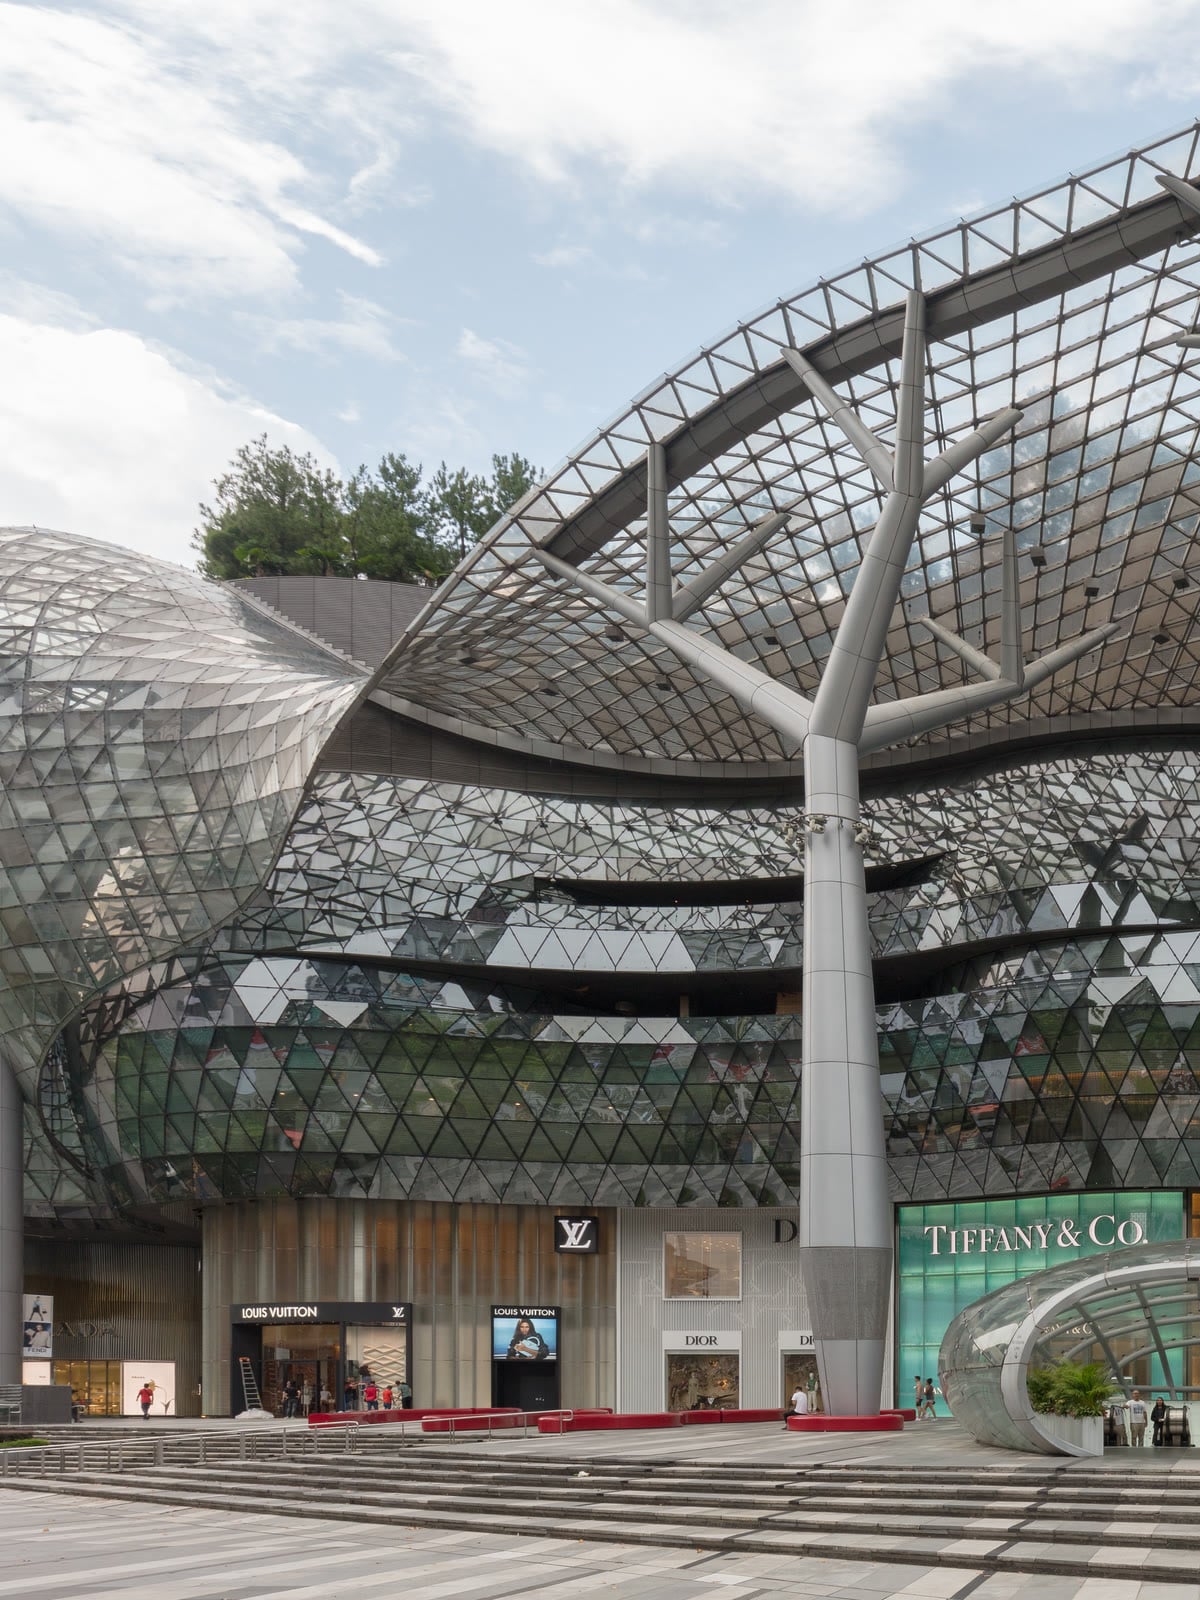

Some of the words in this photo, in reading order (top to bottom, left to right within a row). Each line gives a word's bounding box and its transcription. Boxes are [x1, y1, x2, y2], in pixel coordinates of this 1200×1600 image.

[1056, 1219, 1083, 1248] &
[241, 1307, 268, 1319] LOUIS
[269, 1306, 318, 1318] VUITTON
[494, 1308, 518, 1316] LOUIS
[519, 1308, 556, 1317] VUITTON
[685, 1335, 719, 1346] DIOR
